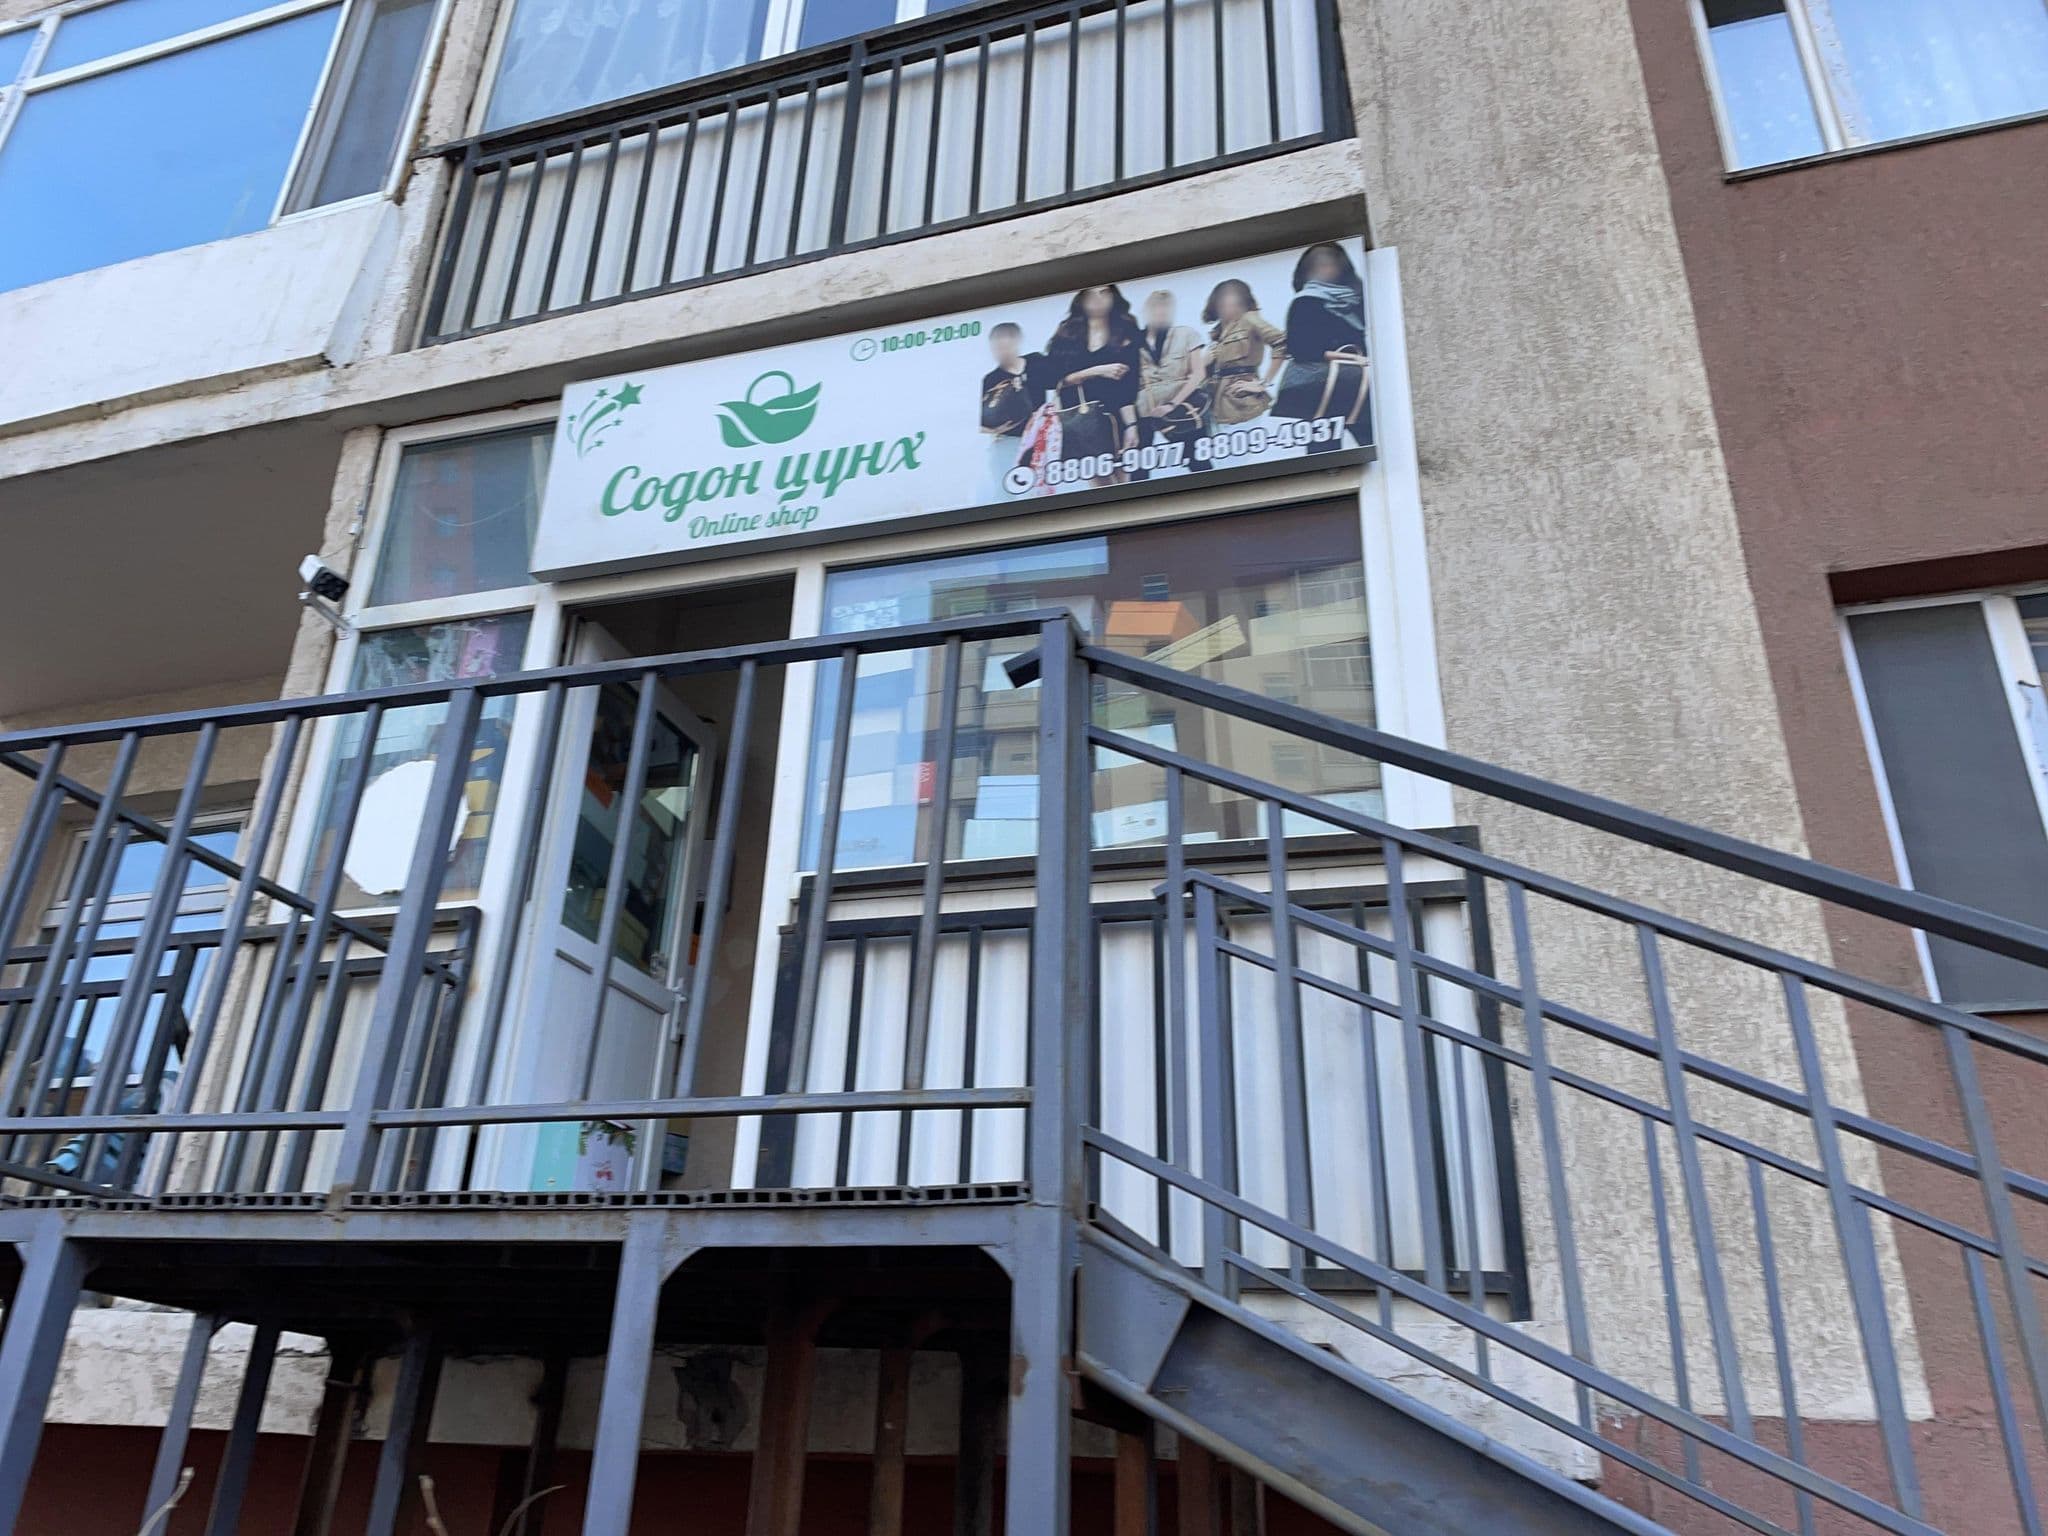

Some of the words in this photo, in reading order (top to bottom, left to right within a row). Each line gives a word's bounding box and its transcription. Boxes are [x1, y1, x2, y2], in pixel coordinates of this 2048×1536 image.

[881, 321, 980, 352] 10:00-20:00
[1194, 416, 1345, 461] 8809-4937
[601, 460, 763, 522] Содон
[688, 512, 761, 539] Online
[765, 504, 819, 530] shop
